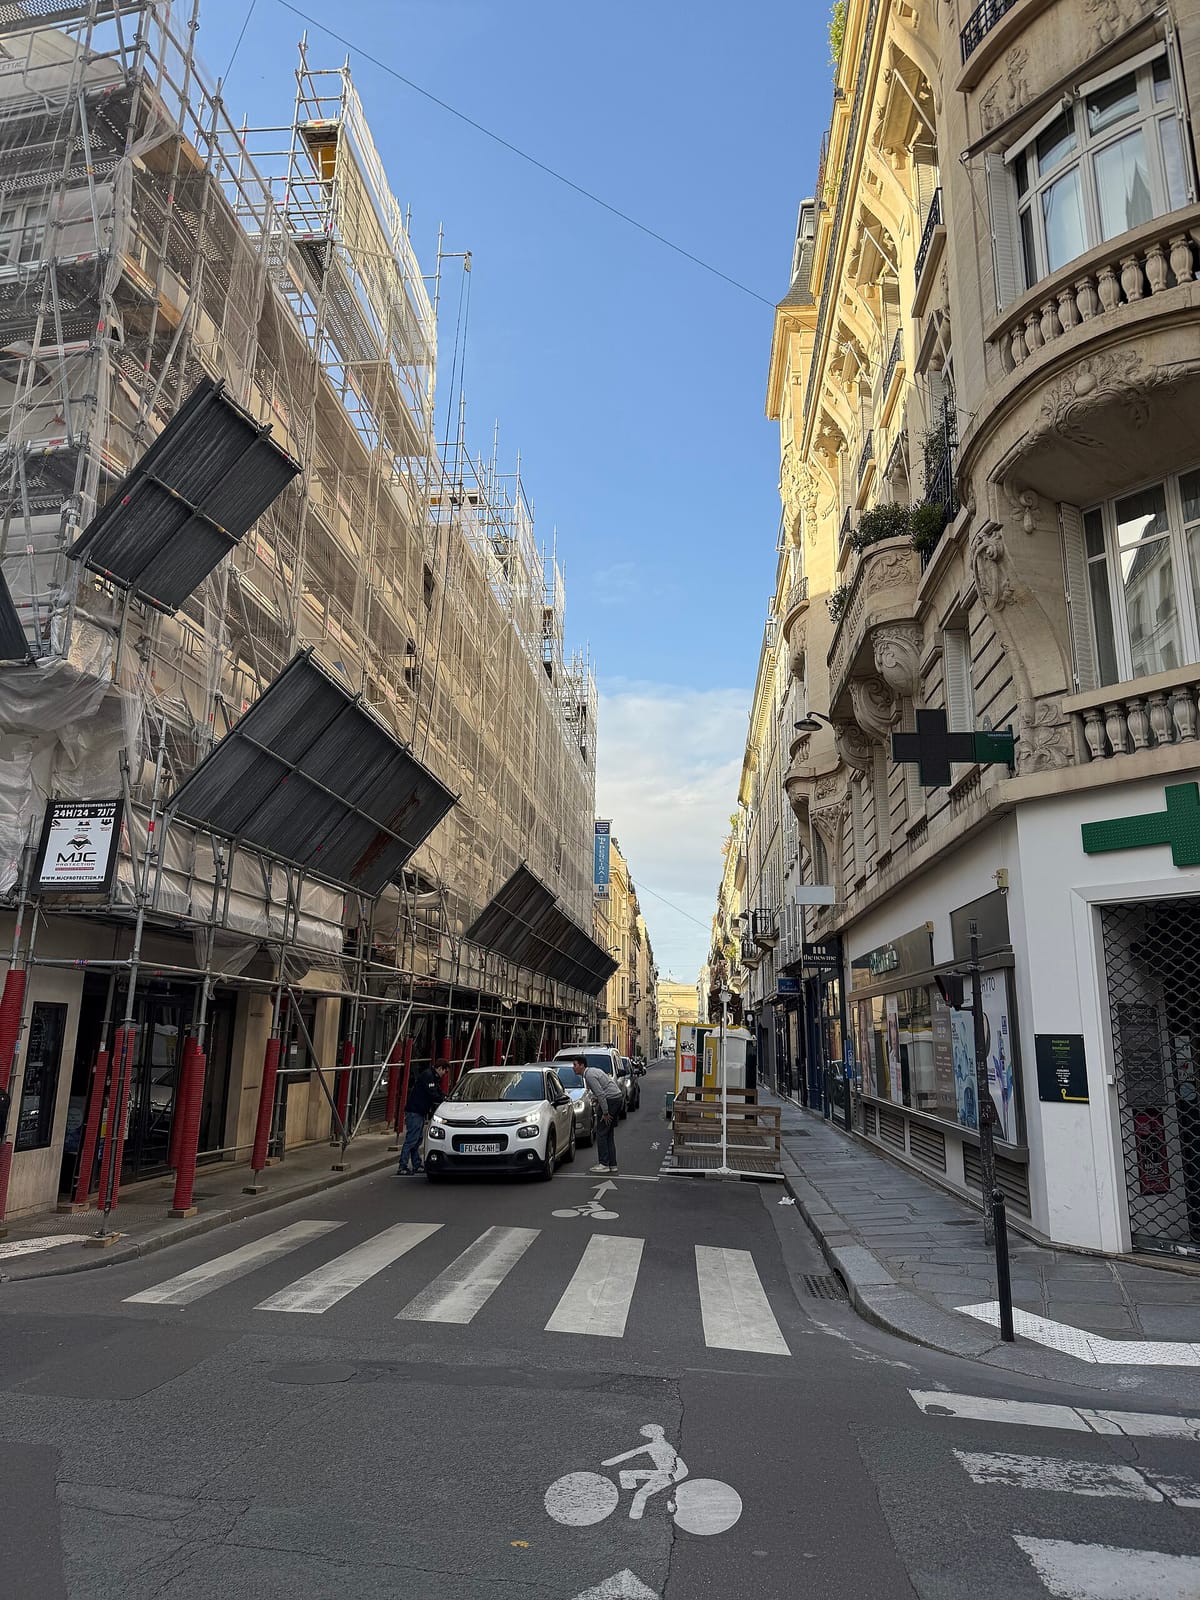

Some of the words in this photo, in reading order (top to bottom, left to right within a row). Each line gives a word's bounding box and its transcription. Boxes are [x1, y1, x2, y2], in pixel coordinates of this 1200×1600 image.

[53, 809, 89, 817] 24H/24
[97, 808, 116, 816] 7J/7
[57, 852, 97, 862] MJC
